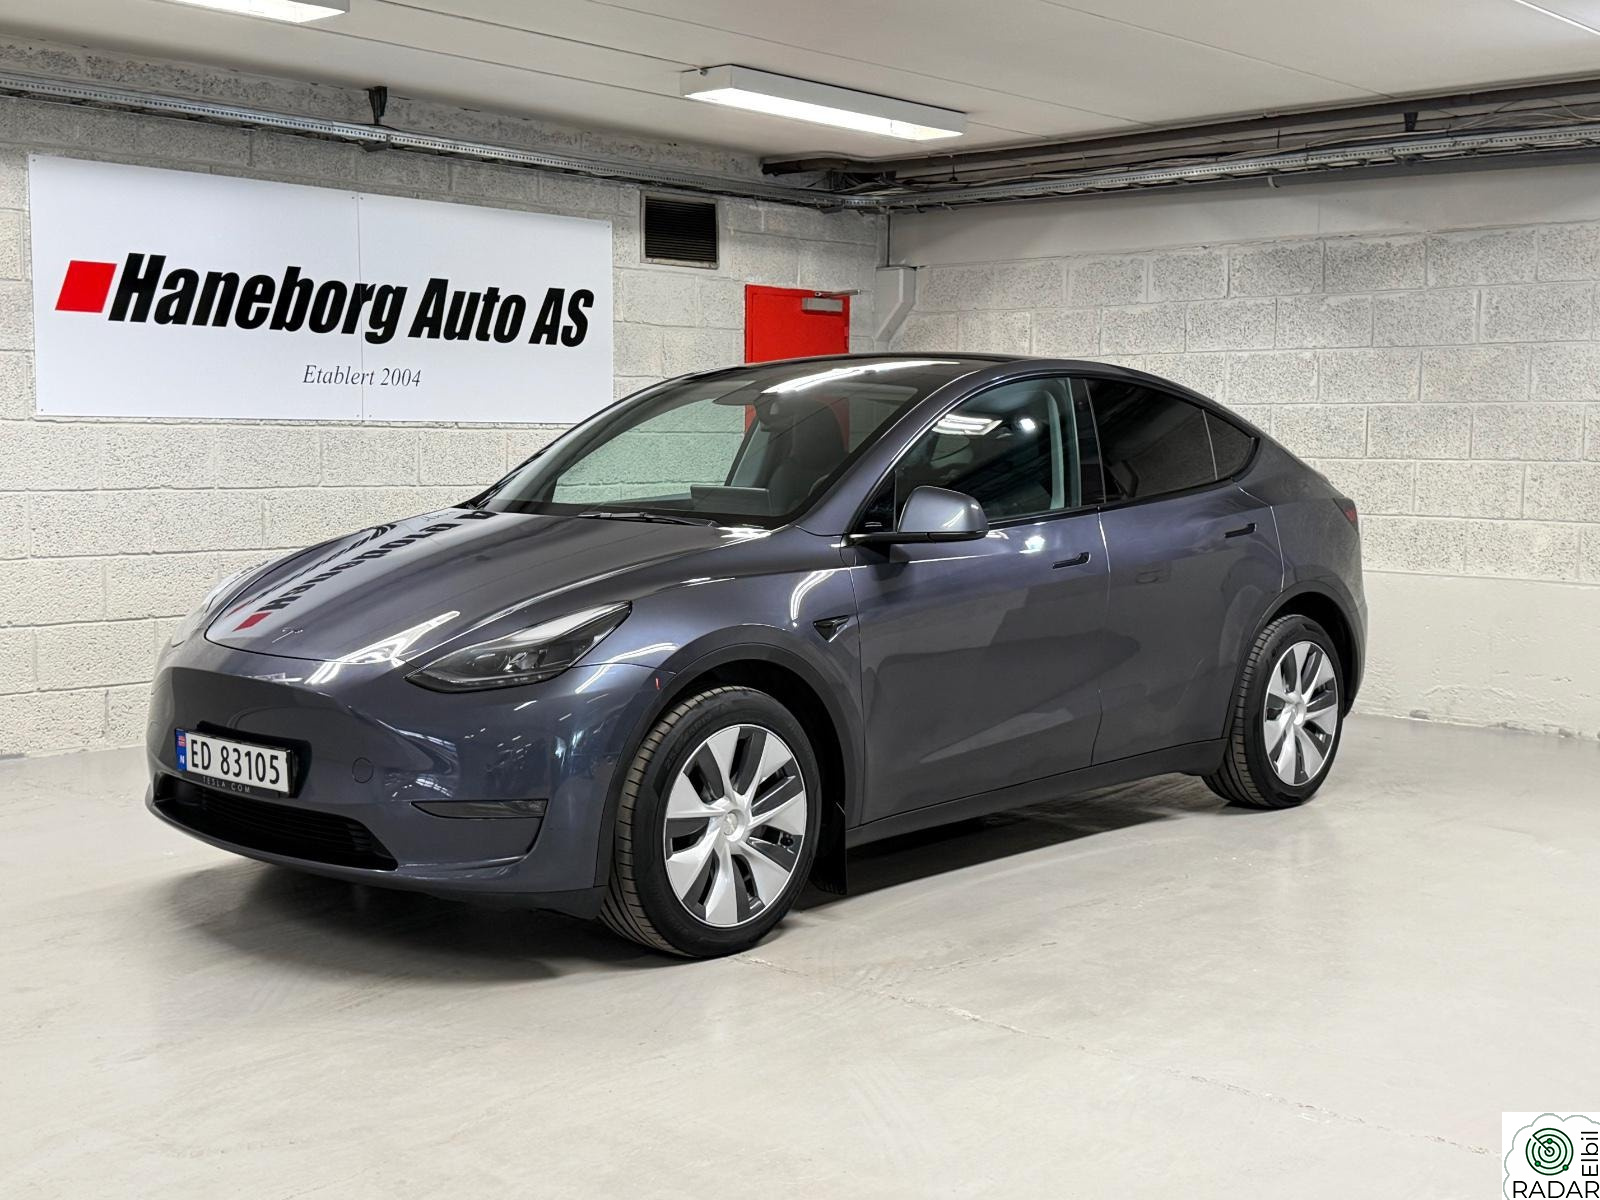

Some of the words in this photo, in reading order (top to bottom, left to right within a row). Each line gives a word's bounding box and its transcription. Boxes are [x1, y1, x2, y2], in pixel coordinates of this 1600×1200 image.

[108, 253, 408, 345] Haneborg
[407, 277, 527, 344] Auto
[528, 287, 595, 348] AS
[303, 364, 375, 386] Etablert
[380, 367, 422, 388] 2004
[190, 738, 212, 771] ED
[220, 745, 280, 785] 83105
[202, 775, 226, 788] TESLA
